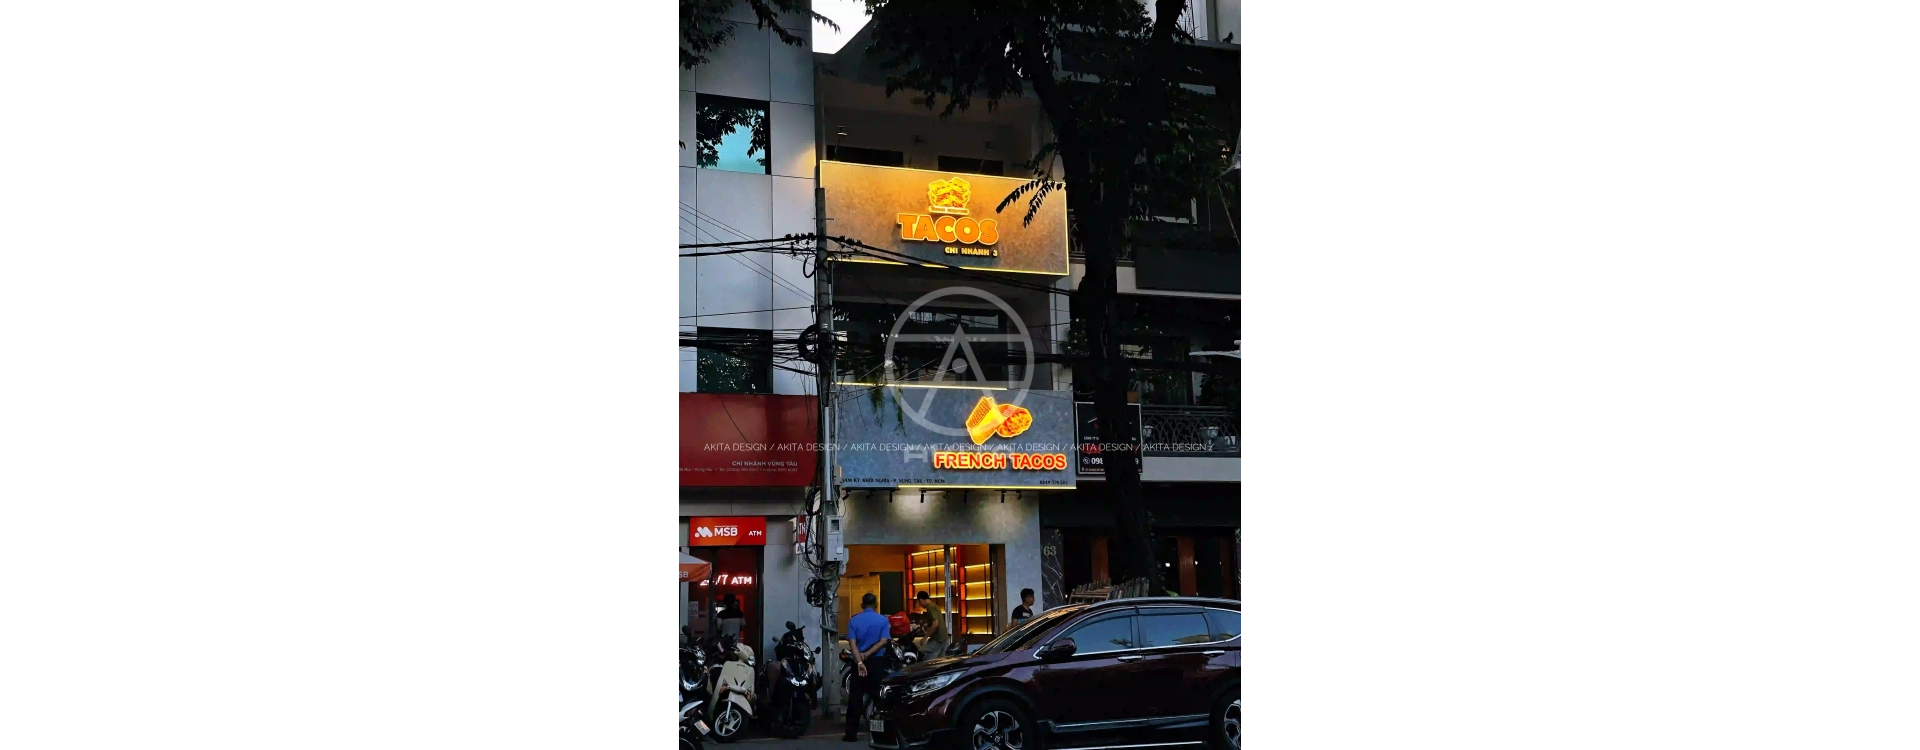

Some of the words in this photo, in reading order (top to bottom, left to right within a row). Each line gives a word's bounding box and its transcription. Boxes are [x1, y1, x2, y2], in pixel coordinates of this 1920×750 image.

[898, 213, 998, 245] TACOS
[944, 246, 959, 254] CHI
[961, 247, 990, 256] NHÁNH
[992, 249, 998, 257] 3
[933, 452, 1006, 469] FRENCH
[1009, 453, 1067, 470] TACOS
[714, 527, 738, 537] MSB
[1043, 545, 1057, 556] 63
[731, 576, 753, 585] ATM
